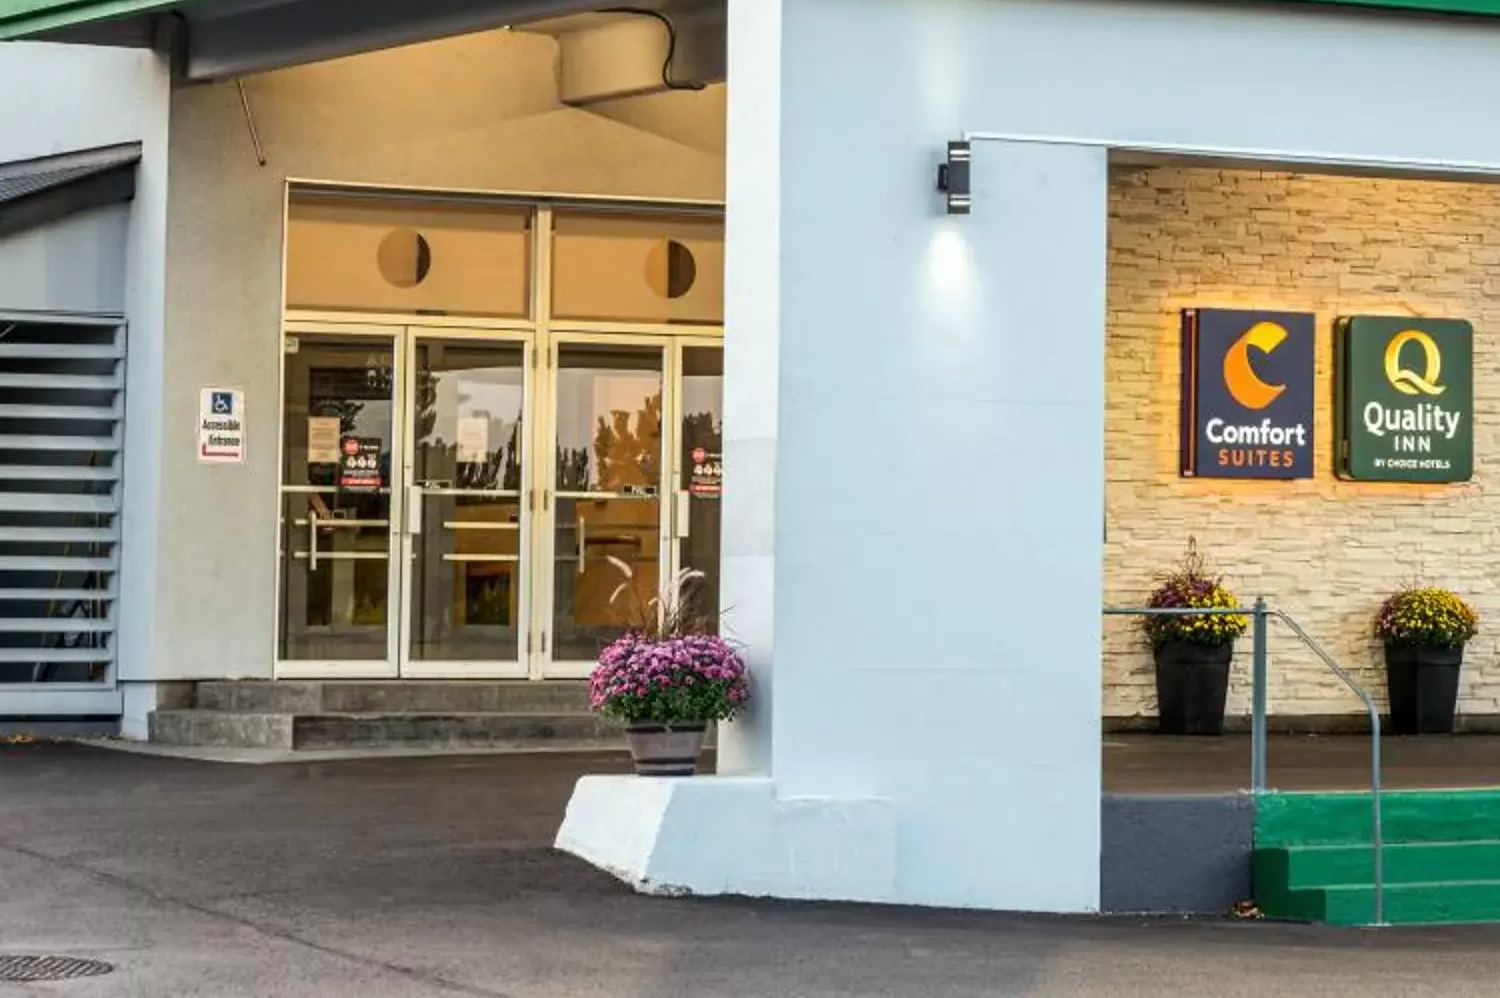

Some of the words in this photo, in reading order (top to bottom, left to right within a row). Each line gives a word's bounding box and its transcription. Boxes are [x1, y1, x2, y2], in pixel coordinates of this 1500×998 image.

[1384, 329, 1446, 395] Q
[1363, 401, 1460, 439] Quality
[208, 434, 240, 446] Entrance
[1205, 417, 1306, 446] Comfort
[1394, 435, 1431, 452] INN
[1217, 449, 1294, 468] SUITES
[1374, 458, 1385, 468] BY
[1387, 459, 1418, 469] CHOICE
[1419, 459, 1451, 470] HOTELS
